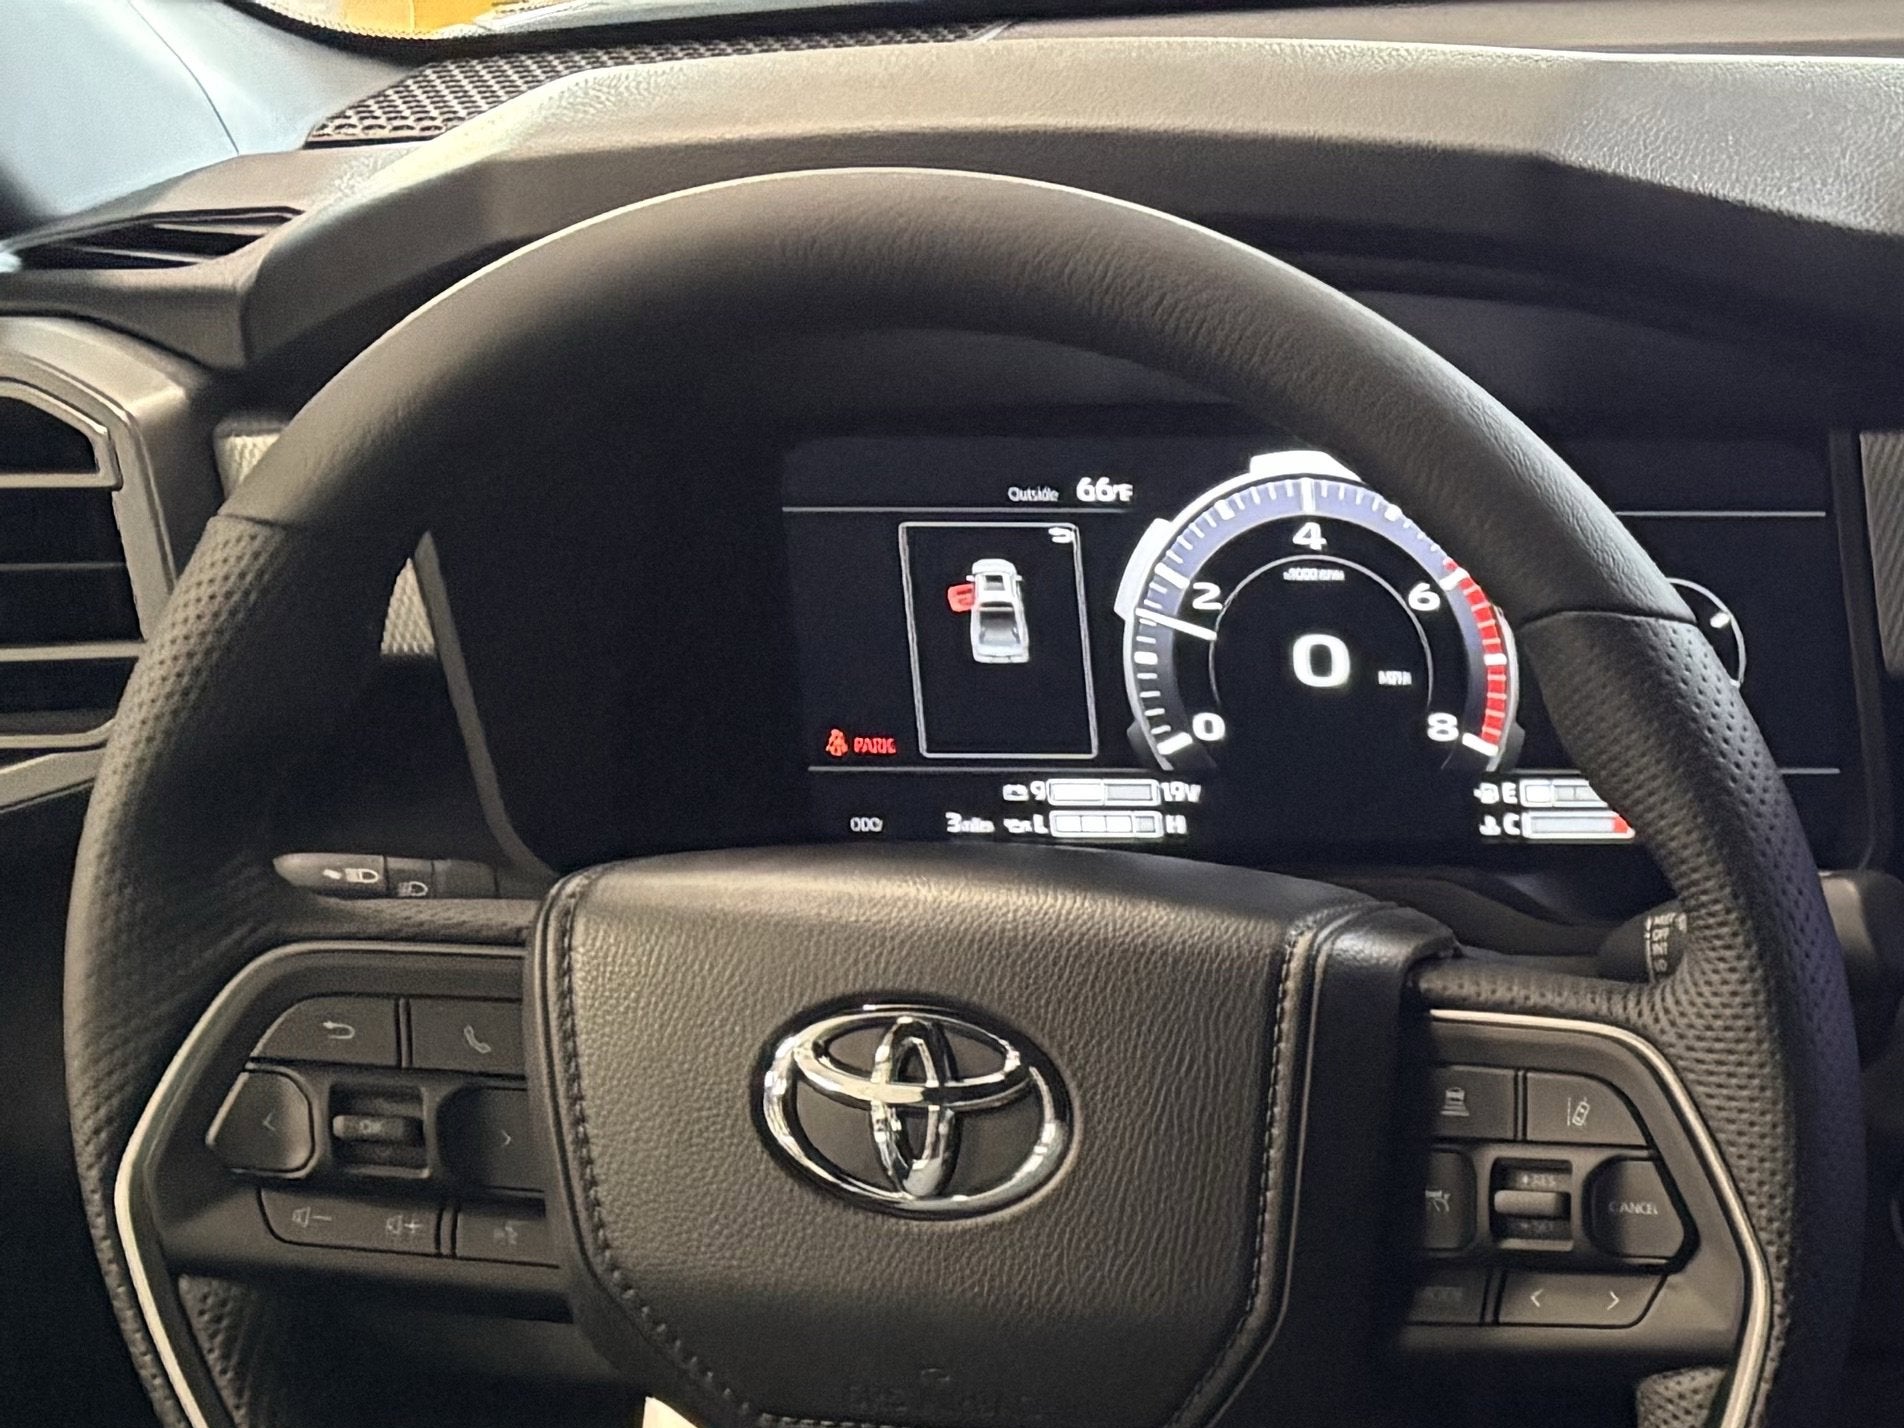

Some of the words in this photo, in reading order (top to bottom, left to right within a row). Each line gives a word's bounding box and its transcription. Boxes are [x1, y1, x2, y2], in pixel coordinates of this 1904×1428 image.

[1008, 486, 1059, 502] Outside
[1293, 522, 1327, 550] 4
[1193, 582, 1222, 610] 2
[1408, 582, 1441, 611] 6
[1293, 634, 1350, 687] 0
[1193, 713, 1225, 741] 0
[1427, 713, 1458, 741] 8
[854, 737, 896, 754] PARK
[1502, 782, 1518, 804] E
[1165, 814, 1186, 834] H
[1503, 813, 1520, 835] C
[1608, 1200, 1658, 1215] CANCEL
